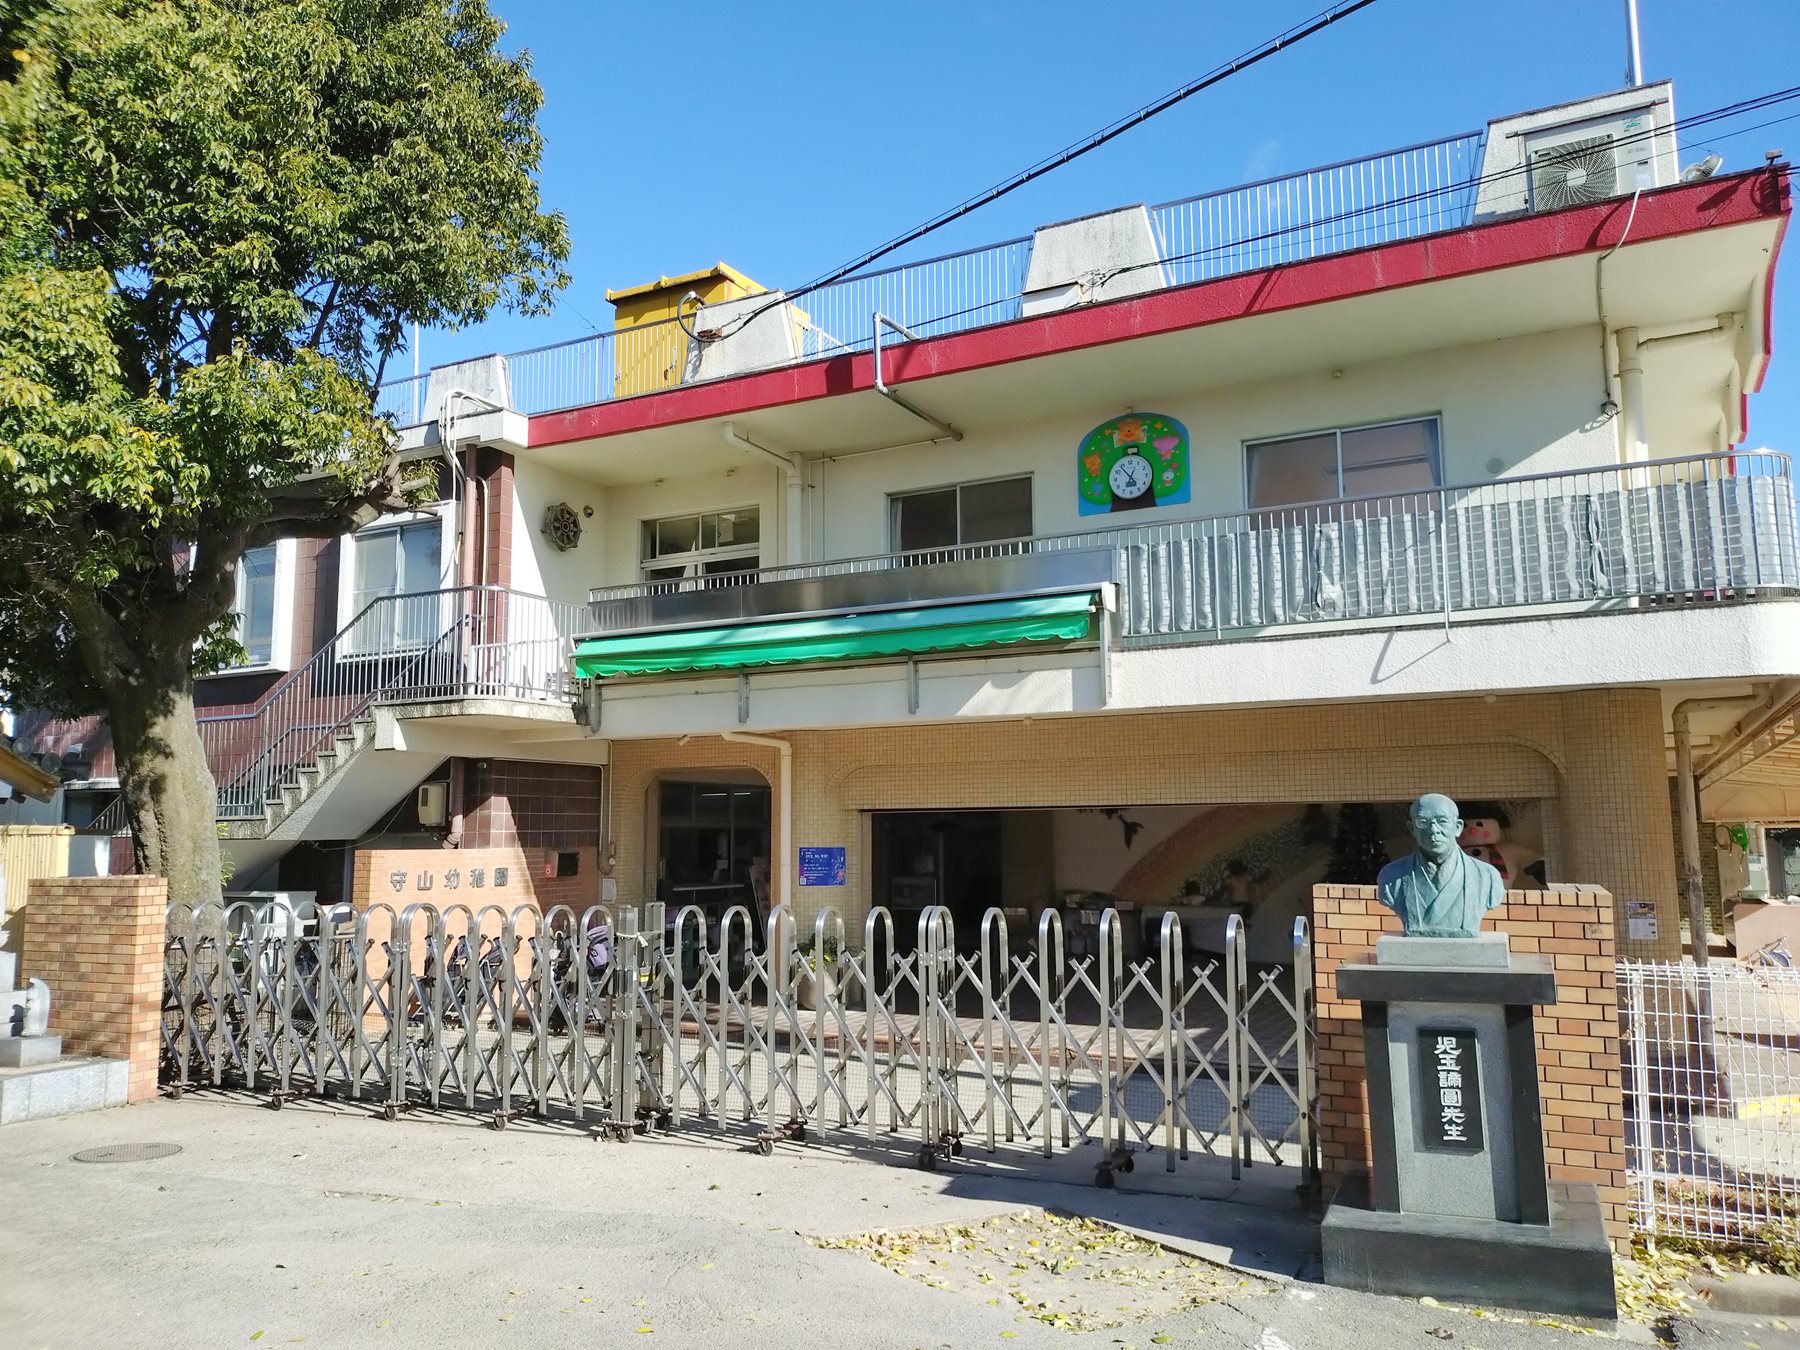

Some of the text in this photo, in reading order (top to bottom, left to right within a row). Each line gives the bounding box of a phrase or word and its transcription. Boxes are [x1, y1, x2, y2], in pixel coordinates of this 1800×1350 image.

[390, 867, 509, 893] 守山幼稚園
